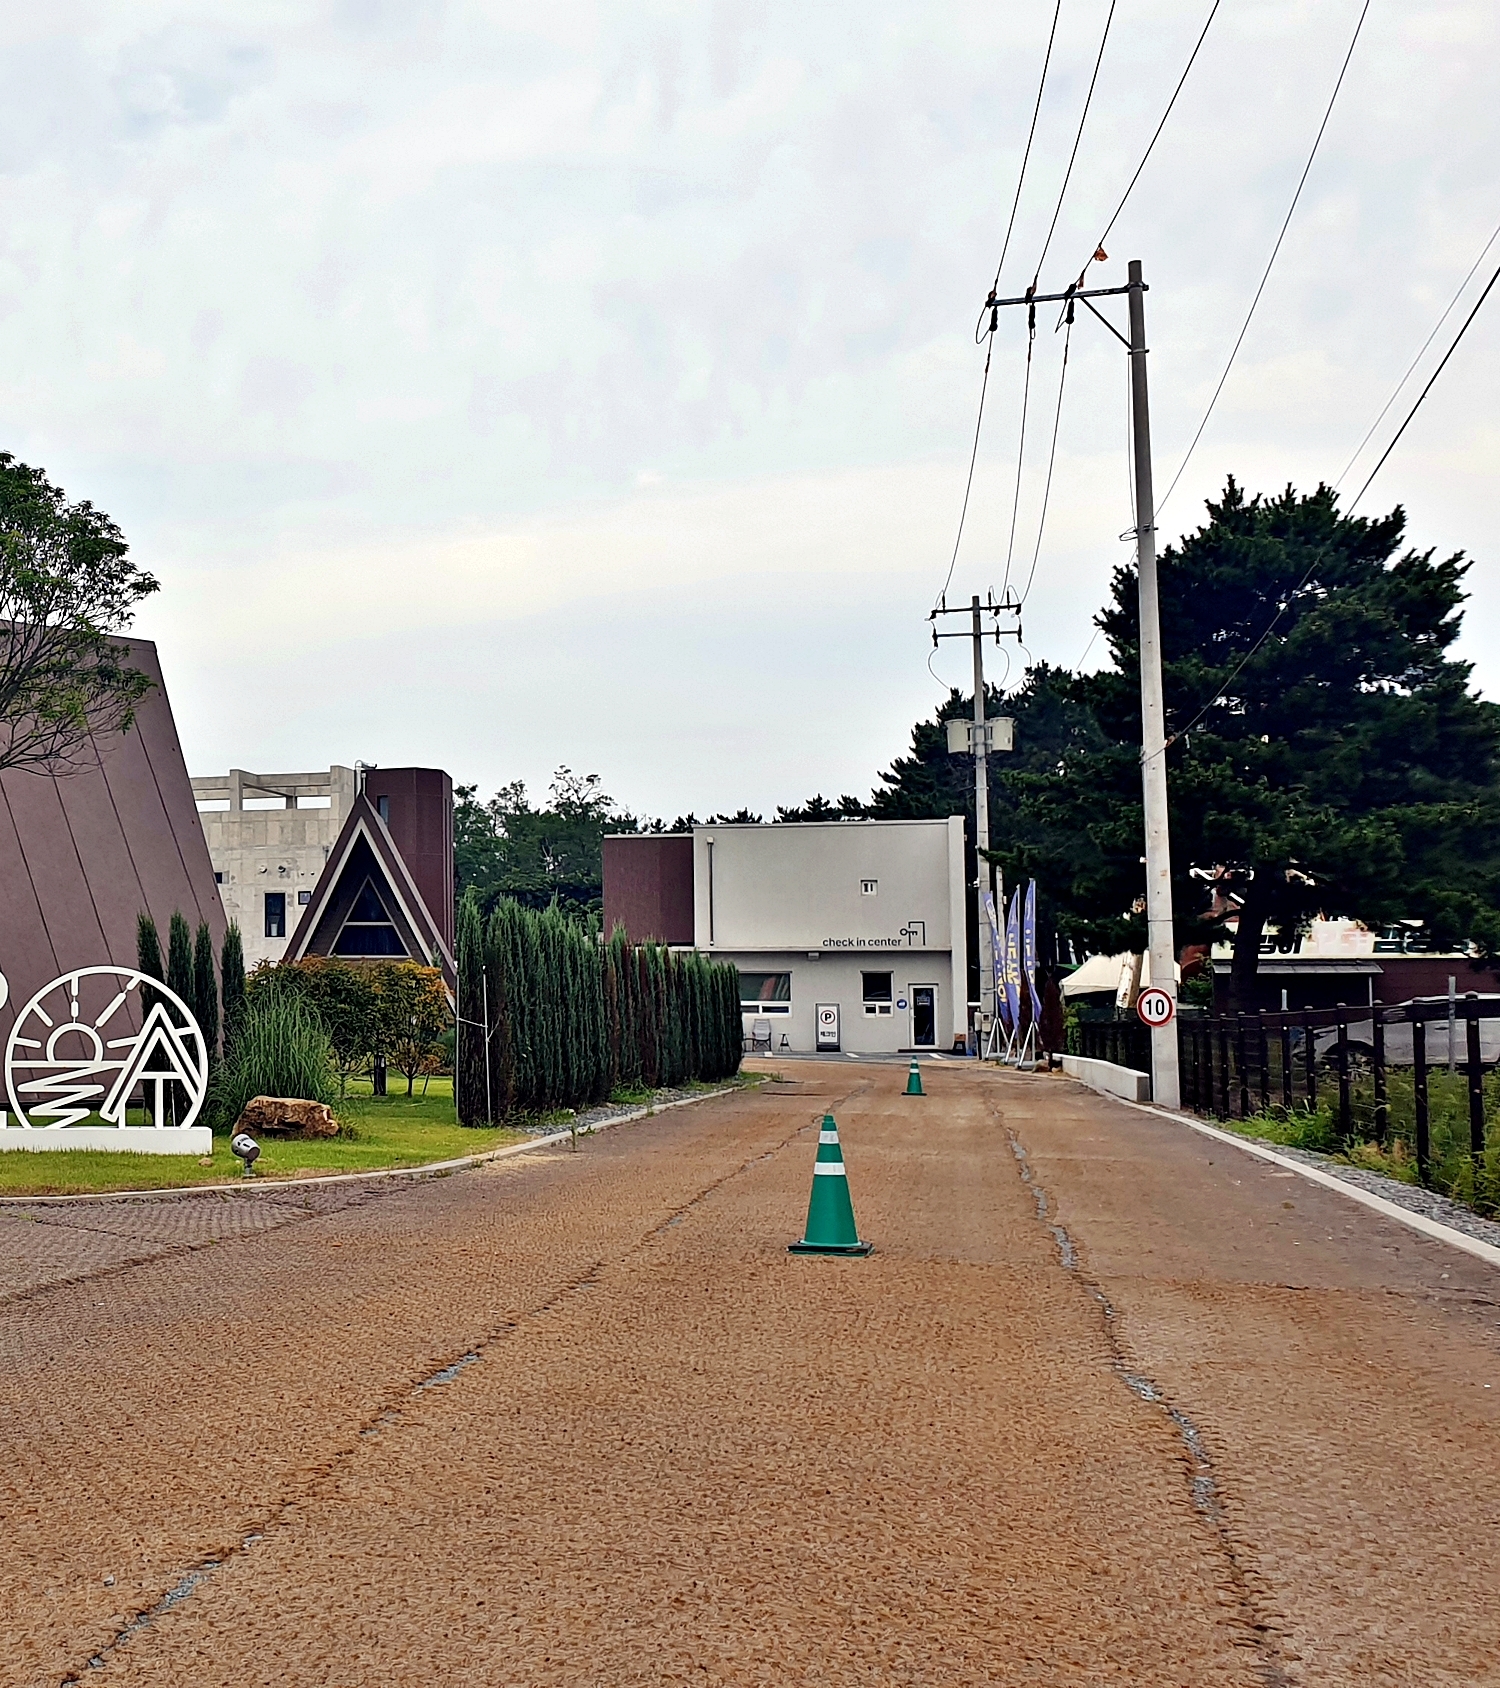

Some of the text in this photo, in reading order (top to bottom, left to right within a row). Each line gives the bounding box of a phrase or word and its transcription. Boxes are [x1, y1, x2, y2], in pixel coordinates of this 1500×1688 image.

[822, 937, 902, 947] check in center
[1145, 999, 1165, 1016] 10
[824, 1013, 832, 1021] P
